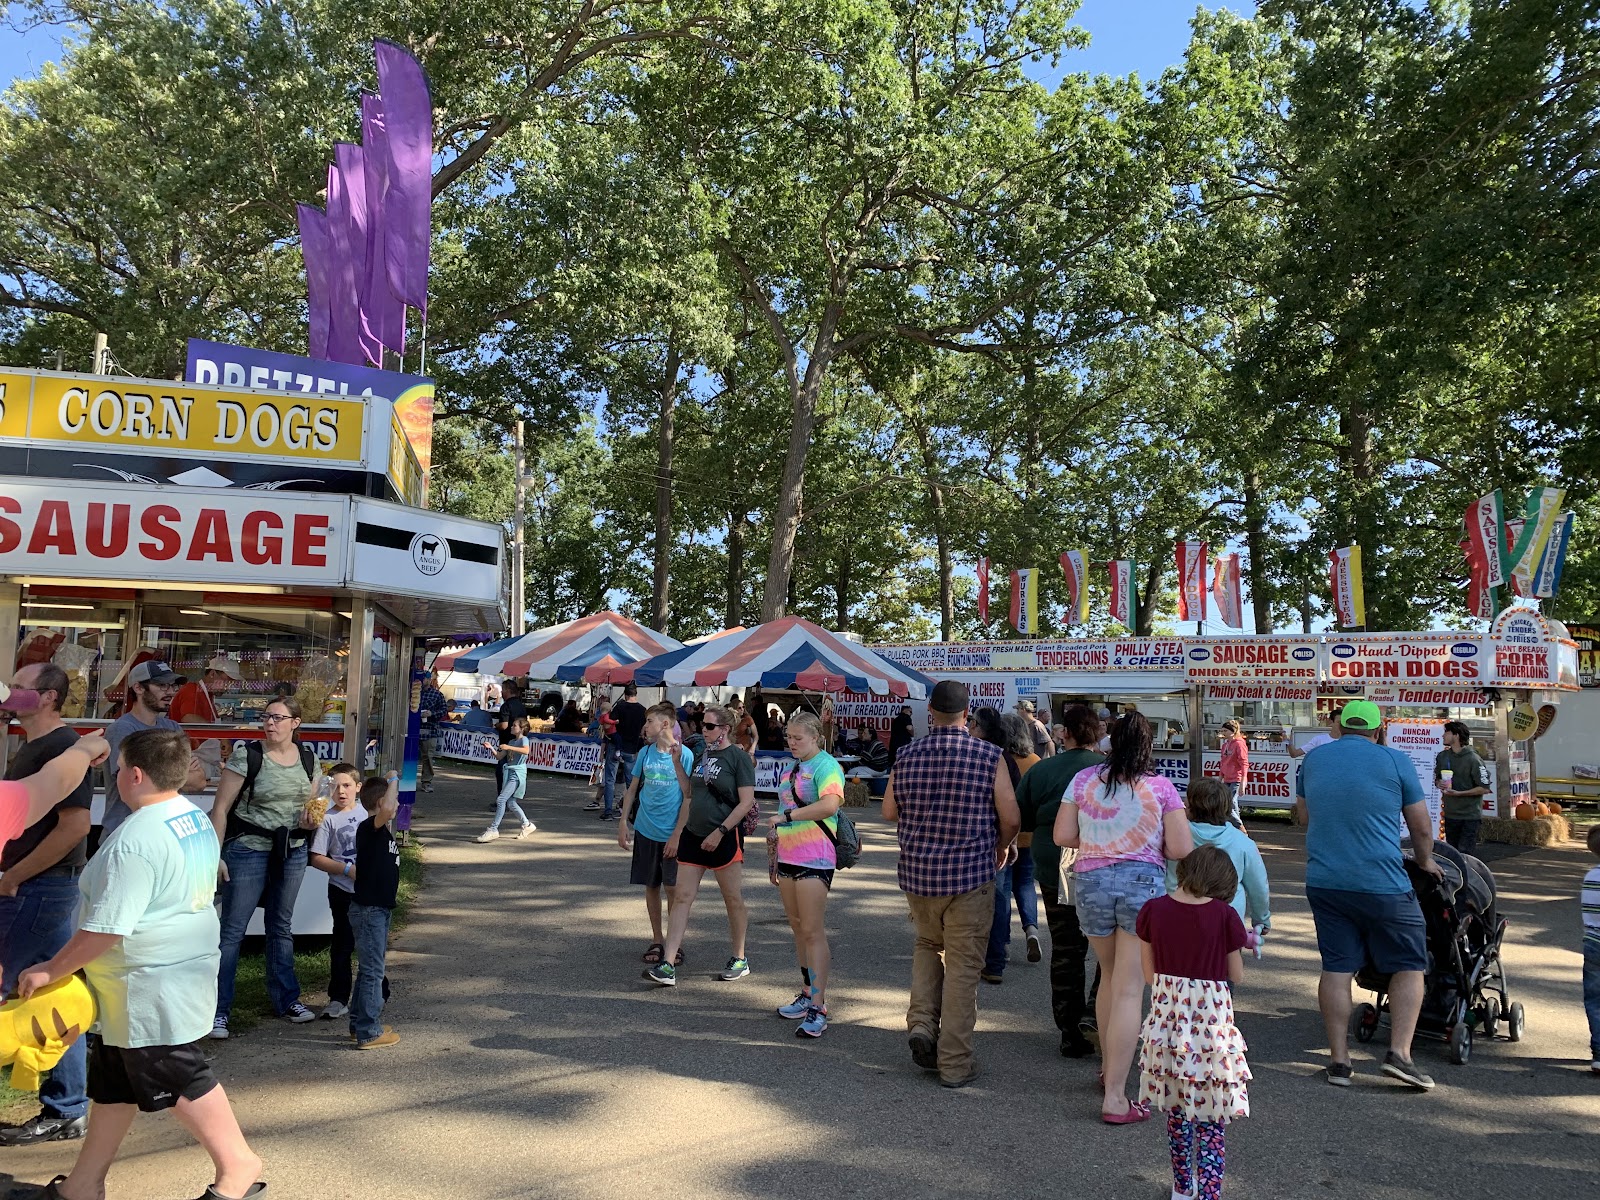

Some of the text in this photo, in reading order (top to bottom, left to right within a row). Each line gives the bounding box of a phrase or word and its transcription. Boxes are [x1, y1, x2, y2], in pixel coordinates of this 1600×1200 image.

[195, 358, 373, 397] PRETZ
[58, 386, 195, 441] CORN
[213, 400, 339, 452] DOGS
[1481, 503, 1500, 583] SAUSAGE
[419, 556, 441, 565] ANGUS
[421, 564, 438, 573] BEEF
[1019, 575, 1028, 630] BURGERS
[1118, 568, 1128, 624] SAUSAG
[1187, 586, 1198, 617] DOGS
[1342, 594, 1352, 625] STEAK
[1510, 619, 1533, 627] CHICKEN
[1508, 626, 1537, 634] TENDERS
[1513, 635, 1531, 643] FRIES
[888, 648, 946, 660] PULLED PORK BBQ
[947, 646, 991, 654] SELF-SERVE
[1115, 642, 1184, 656] PHILLY STEA
[1212, 645, 1289, 664] SAUSAGE
[1294, 650, 1314, 658] POLISH
[1357, 644, 1449, 659] Hand-Dipped
[1452, 646, 1476, 654] REGULAR
[897, 659, 945, 667] NDWICHES
[947, 653, 971, 666] FOUNTAIN
[972, 653, 991, 666] DRINKS
[1036, 650, 1109, 665] TENDERLOINS
[1113, 656, 1122, 665] &
[1495, 652, 1548, 666] PORK
[1188, 668, 1316, 677] ONIONS & PEPPERS
[1331, 660, 1479, 678] CORN DOGS
[1496, 665, 1549, 678] TENDERLOINS
[1015, 678, 1040, 686] BOTTLED
[972, 684, 978, 696] &
[979, 683, 1005, 697] CHEESE
[1209, 685, 1235, 699] Philly
[1236, 686, 1265, 698] Steak
[1265, 686, 1272, 699] &
[1274, 686, 1312, 700] Cheese
[1374, 687, 1391, 695] Giant
[1398, 688, 1487, 704] Tenderloins
[836, 692, 868, 702] CORN
[854, 704, 888, 716] BREADED
[889, 705, 901, 716] PO
[969, 699, 1005, 713] ANDWICH
[834, 716, 892, 730] ENDRLO
[1402, 728, 1431, 736] DUNCAN
[443, 730, 472, 756] SAUSAGE
[473, 734, 500, 747] HOTD
[1248, 739, 1271, 751] TEA
[1392, 736, 1440, 745] CONCESSIONS
[301, 741, 345, 759] DRI
[472, 746, 497, 760] HAMBU
[557, 745, 600, 762] PHILLY STEAK
[555, 760, 561, 768] &
[1204, 760, 1290, 771] GIA READED
[1244, 784, 1290, 797] RLOINS
[1510, 782, 1530, 795] ORK
[168, 814, 199, 840] REEL
